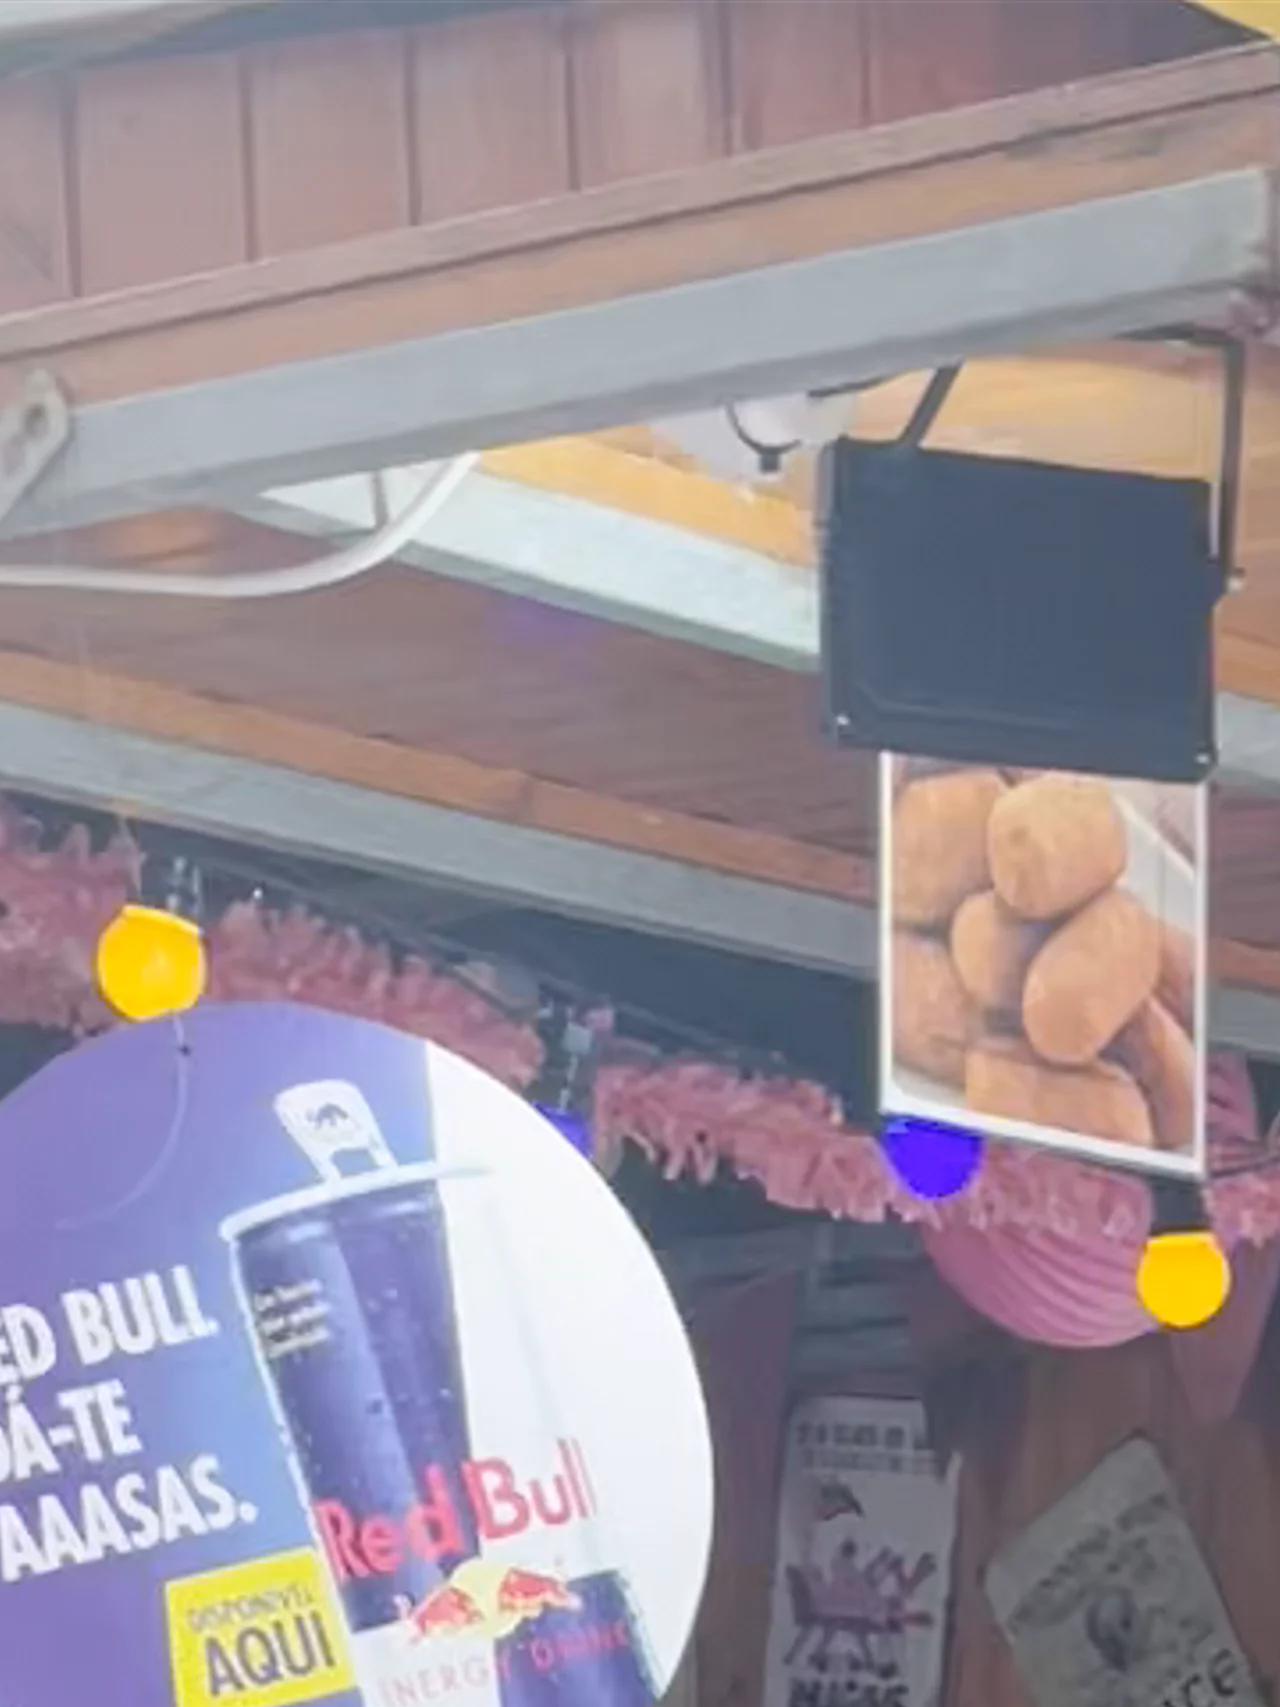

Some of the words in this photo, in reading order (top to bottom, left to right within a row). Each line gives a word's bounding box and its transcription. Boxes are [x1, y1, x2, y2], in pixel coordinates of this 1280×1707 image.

[60, 1265, 218, 1366] BULL
[313, 1462, 463, 1582] Red
[461, 1436, 597, 1540] Bull
[204, 1611, 335, 1697] AQUI
